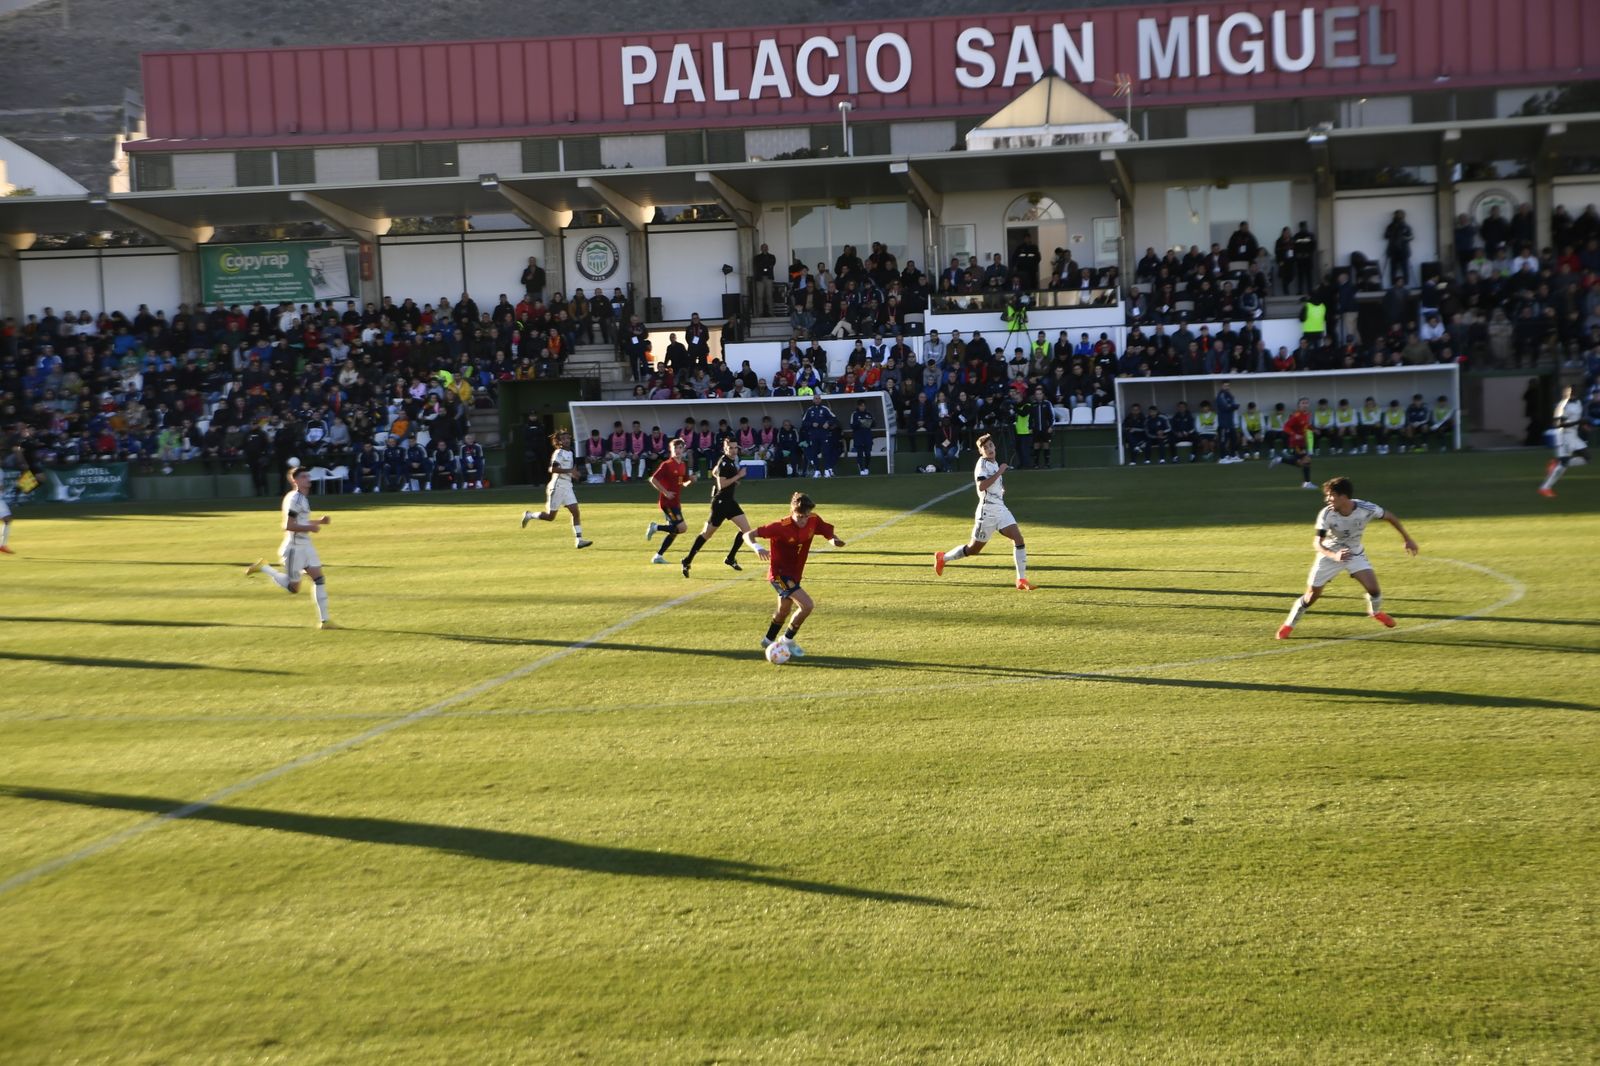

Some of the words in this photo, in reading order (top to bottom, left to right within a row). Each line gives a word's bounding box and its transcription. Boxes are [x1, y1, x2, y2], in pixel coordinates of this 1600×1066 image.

[621, 31, 913, 106] PALACIO
[955, 21, 1096, 89] SAN
[1137, 5, 1397, 80] MIGUEL
[225, 253, 289, 270] copyrap
[87, 475, 121, 484] ESPADA
[797, 543, 803, 555] 7
